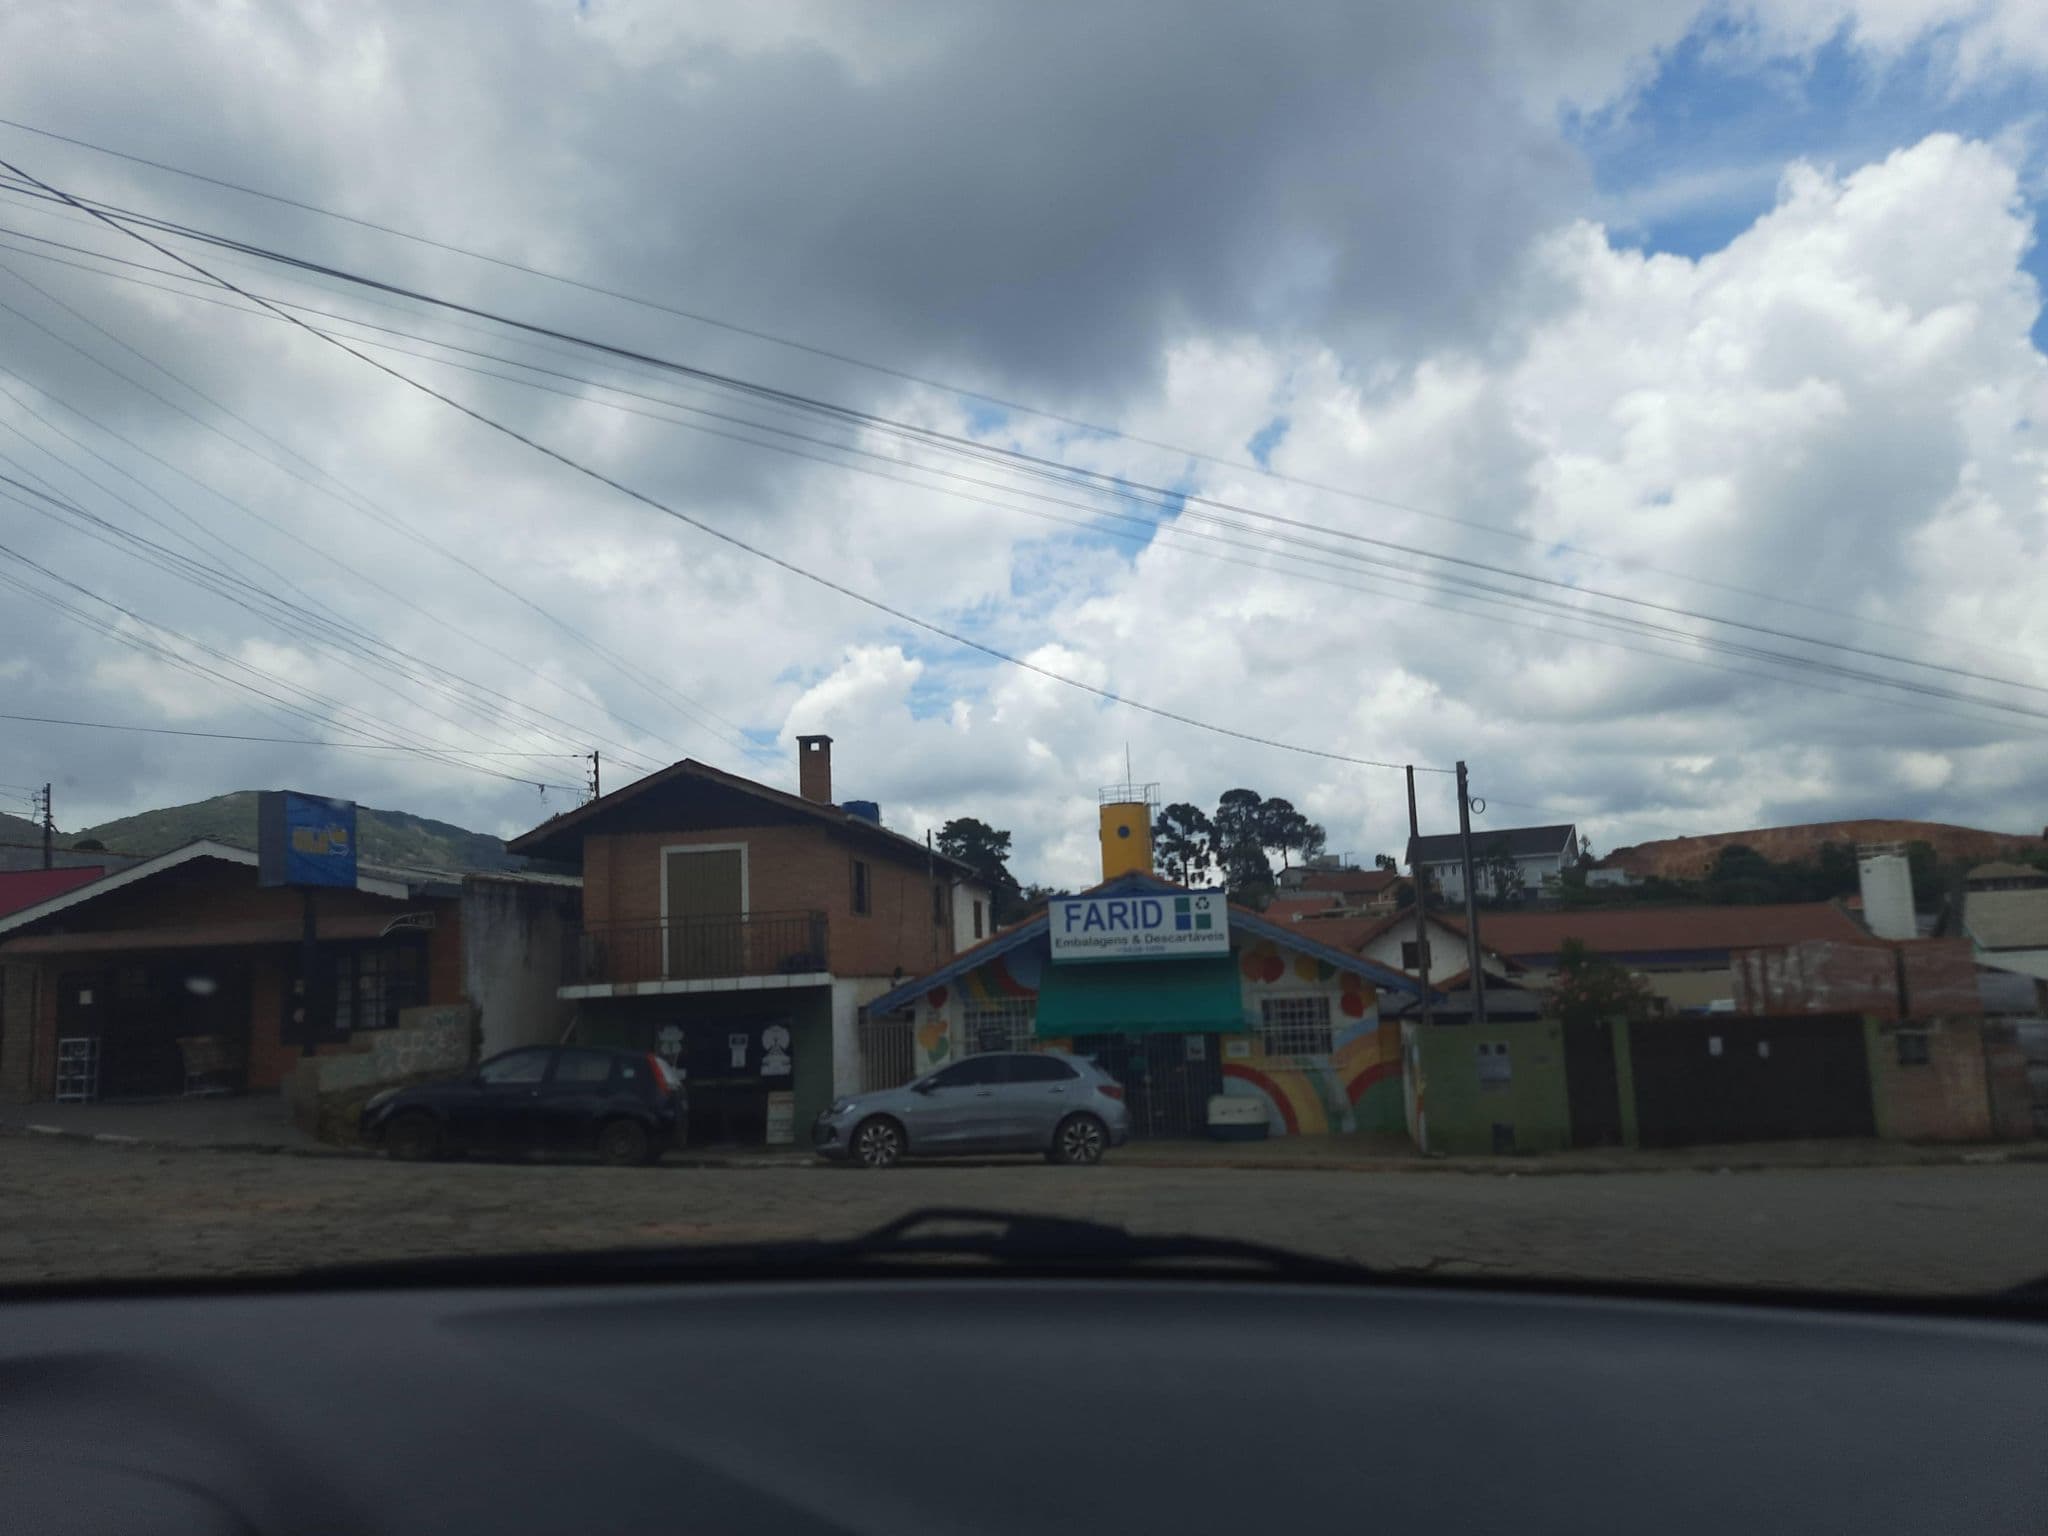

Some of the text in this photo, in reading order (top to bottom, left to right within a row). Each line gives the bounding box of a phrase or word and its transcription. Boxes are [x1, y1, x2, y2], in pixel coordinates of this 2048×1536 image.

[1065, 900, 1163, 932] FARID
[1055, 935, 1128, 949] Embalagens
[1131, 935, 1141, 944] &
